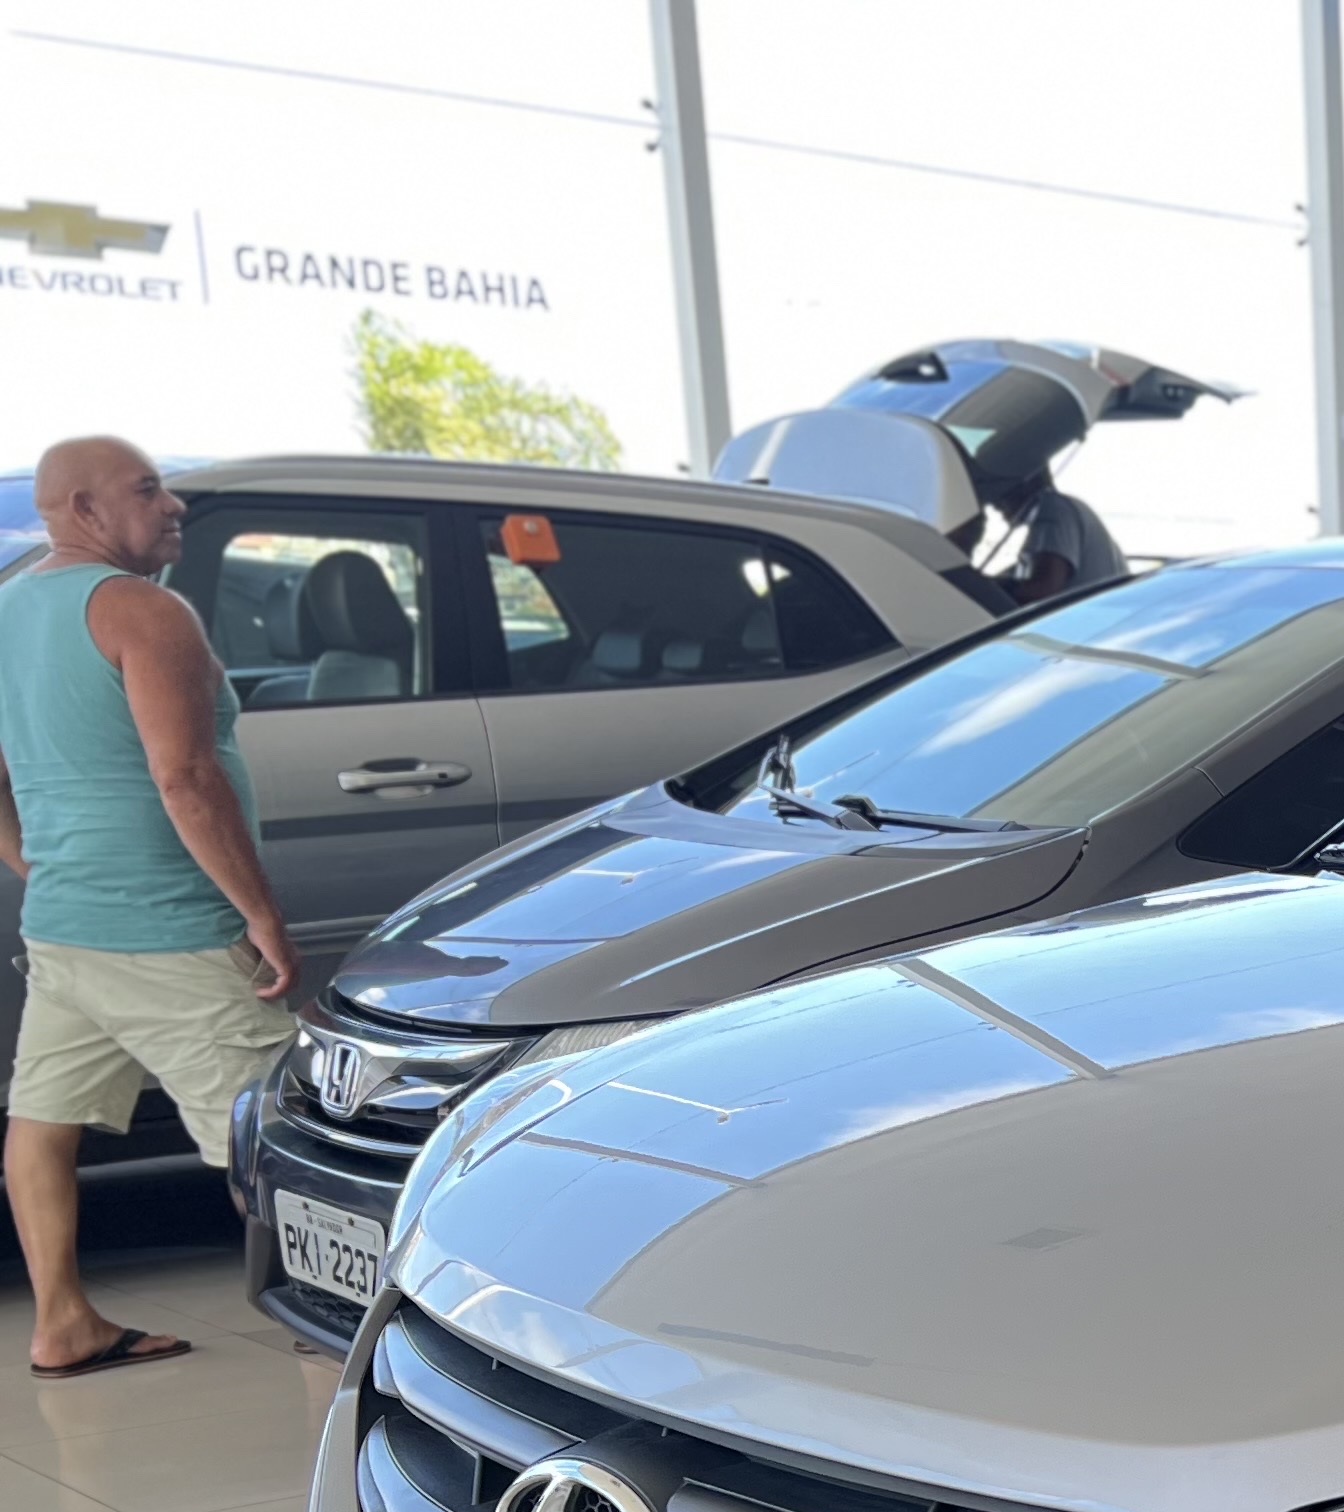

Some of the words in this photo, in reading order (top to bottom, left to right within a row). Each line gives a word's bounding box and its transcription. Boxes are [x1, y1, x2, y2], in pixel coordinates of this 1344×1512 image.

[0, 265, 183, 302] EVROLET
[234, 245, 412, 297] GRANDE
[425, 264, 550, 312] BAHIA
